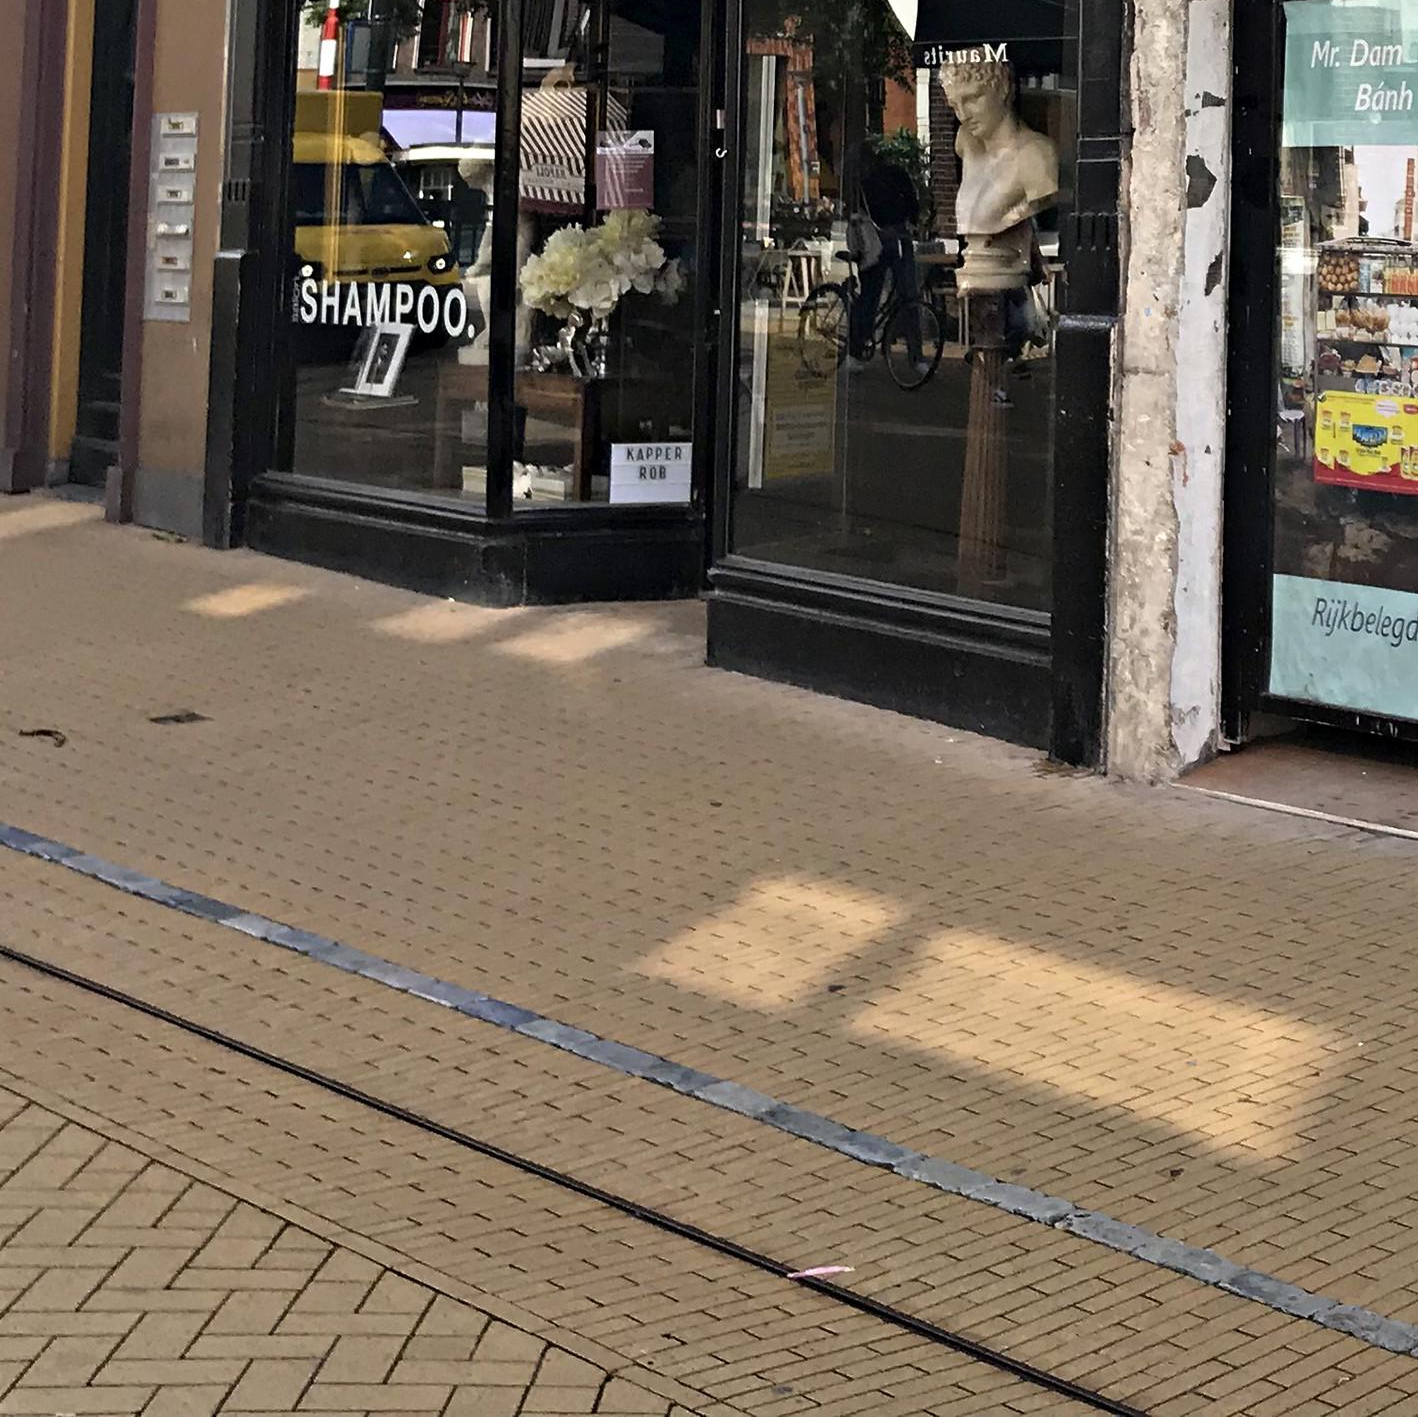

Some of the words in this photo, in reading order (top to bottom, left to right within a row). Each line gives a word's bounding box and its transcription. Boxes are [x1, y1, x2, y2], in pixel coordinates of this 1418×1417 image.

[1311, 40, 1341, 69] Mr.
[1350, 38, 1402, 67] Dam
[1354, 79, 1413, 111] Bánh
[301, 278, 475, 339] SHAMPOO.
[626, 446, 682, 462] KAPPER
[639, 465, 667, 480] ROB
